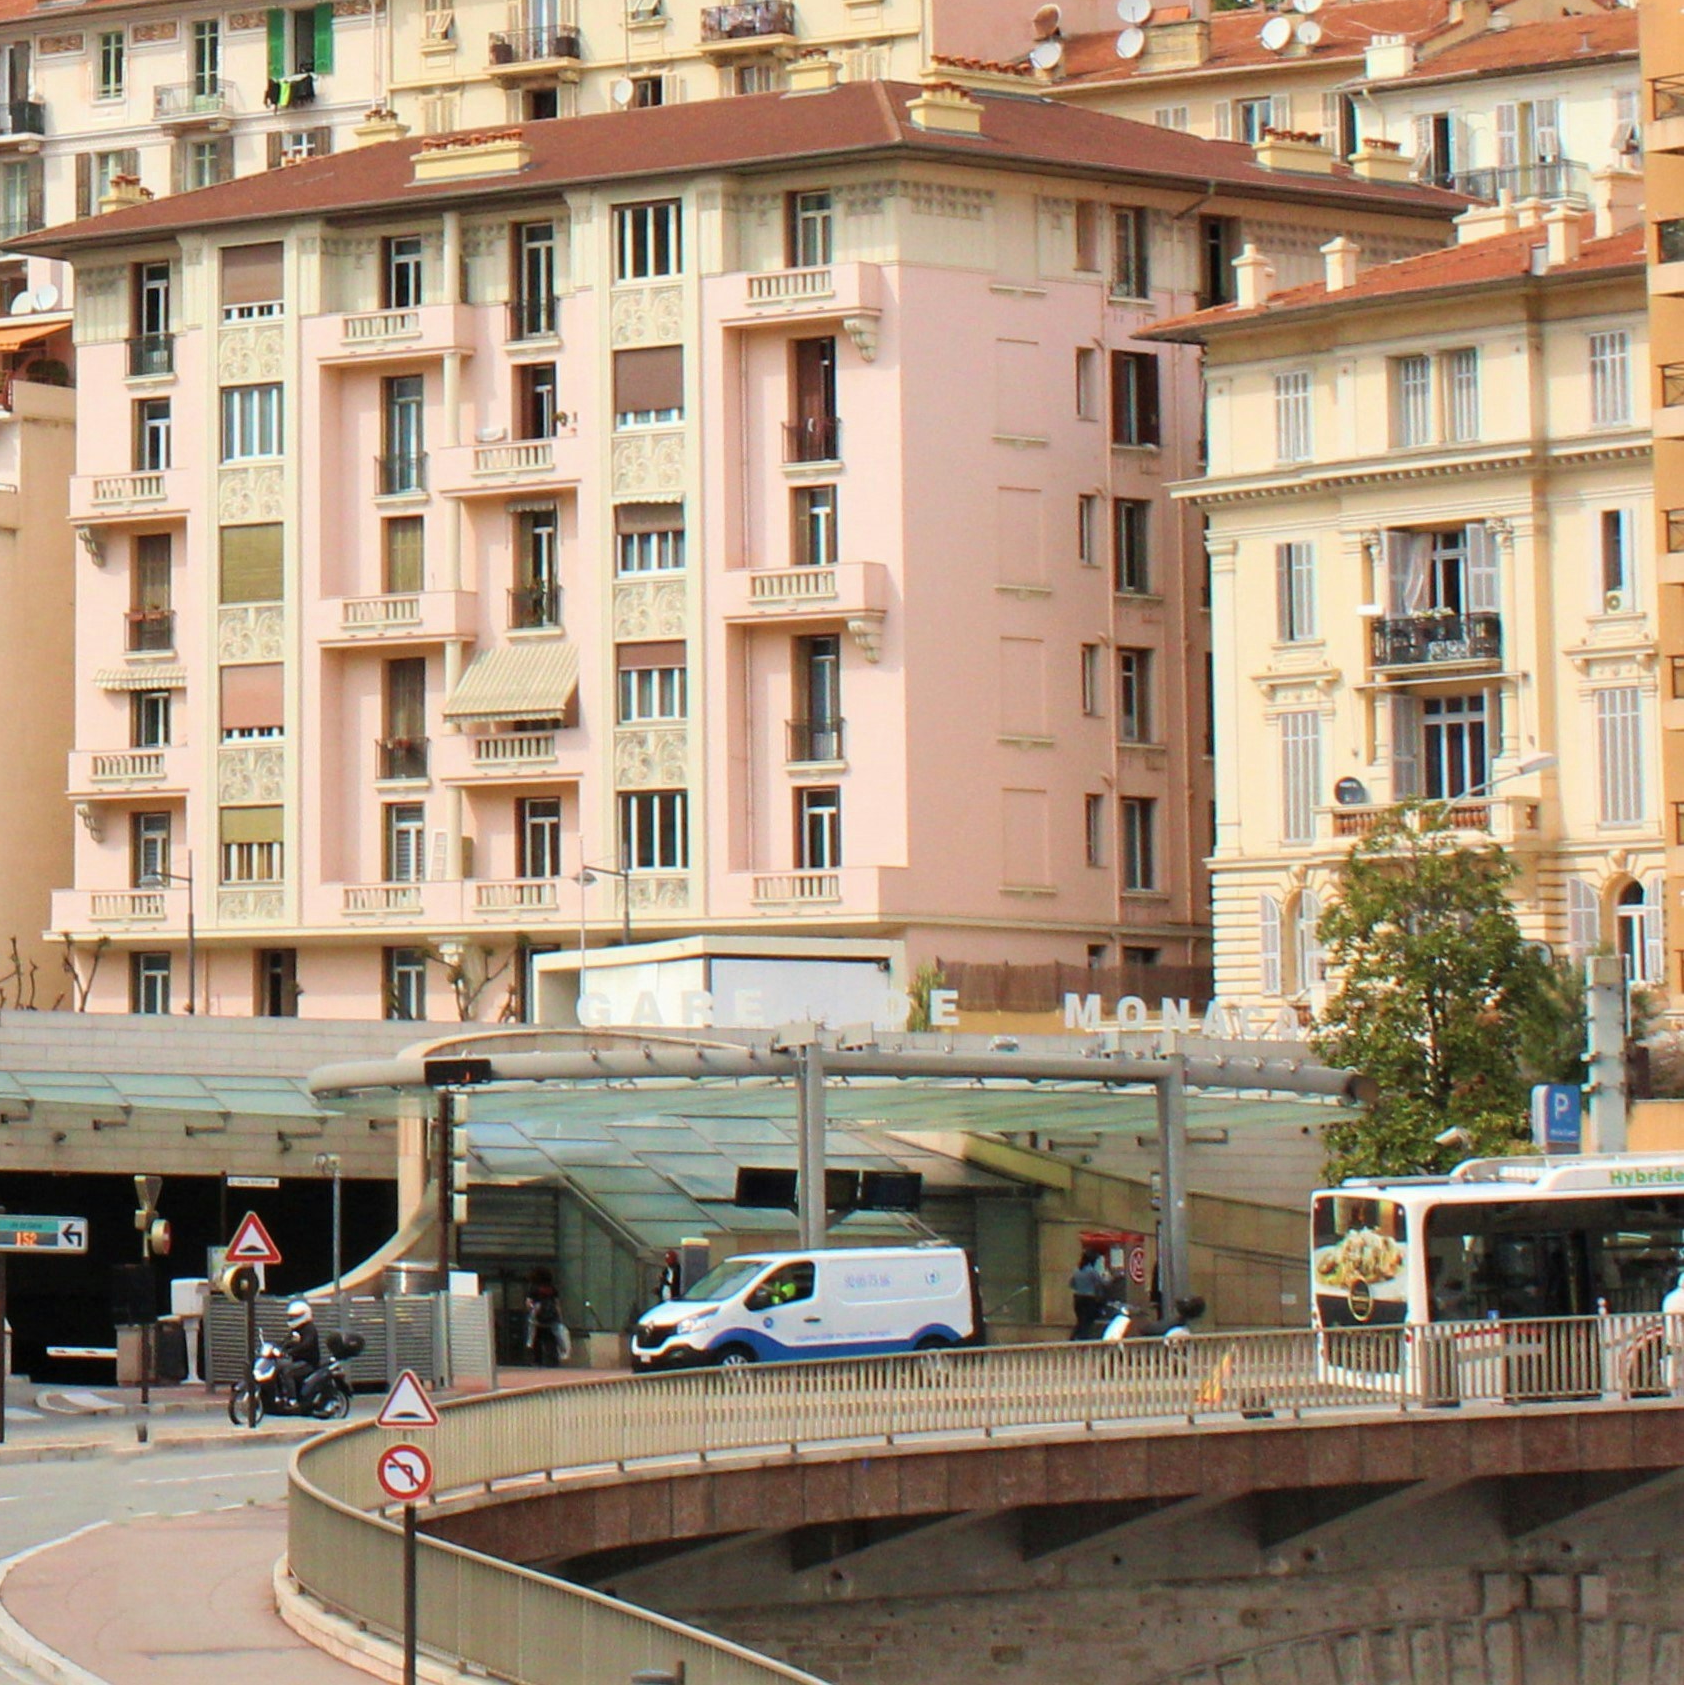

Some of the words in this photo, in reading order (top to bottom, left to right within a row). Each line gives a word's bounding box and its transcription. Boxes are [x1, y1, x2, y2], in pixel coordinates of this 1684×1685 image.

[577, 990, 763, 1028] GARE
[880, 989, 959, 1026] DE
[1063, 992, 1300, 1040] MONACO
[1555, 1092, 1570, 1120] P
[1610, 1166, 1684, 1186] Hybride
